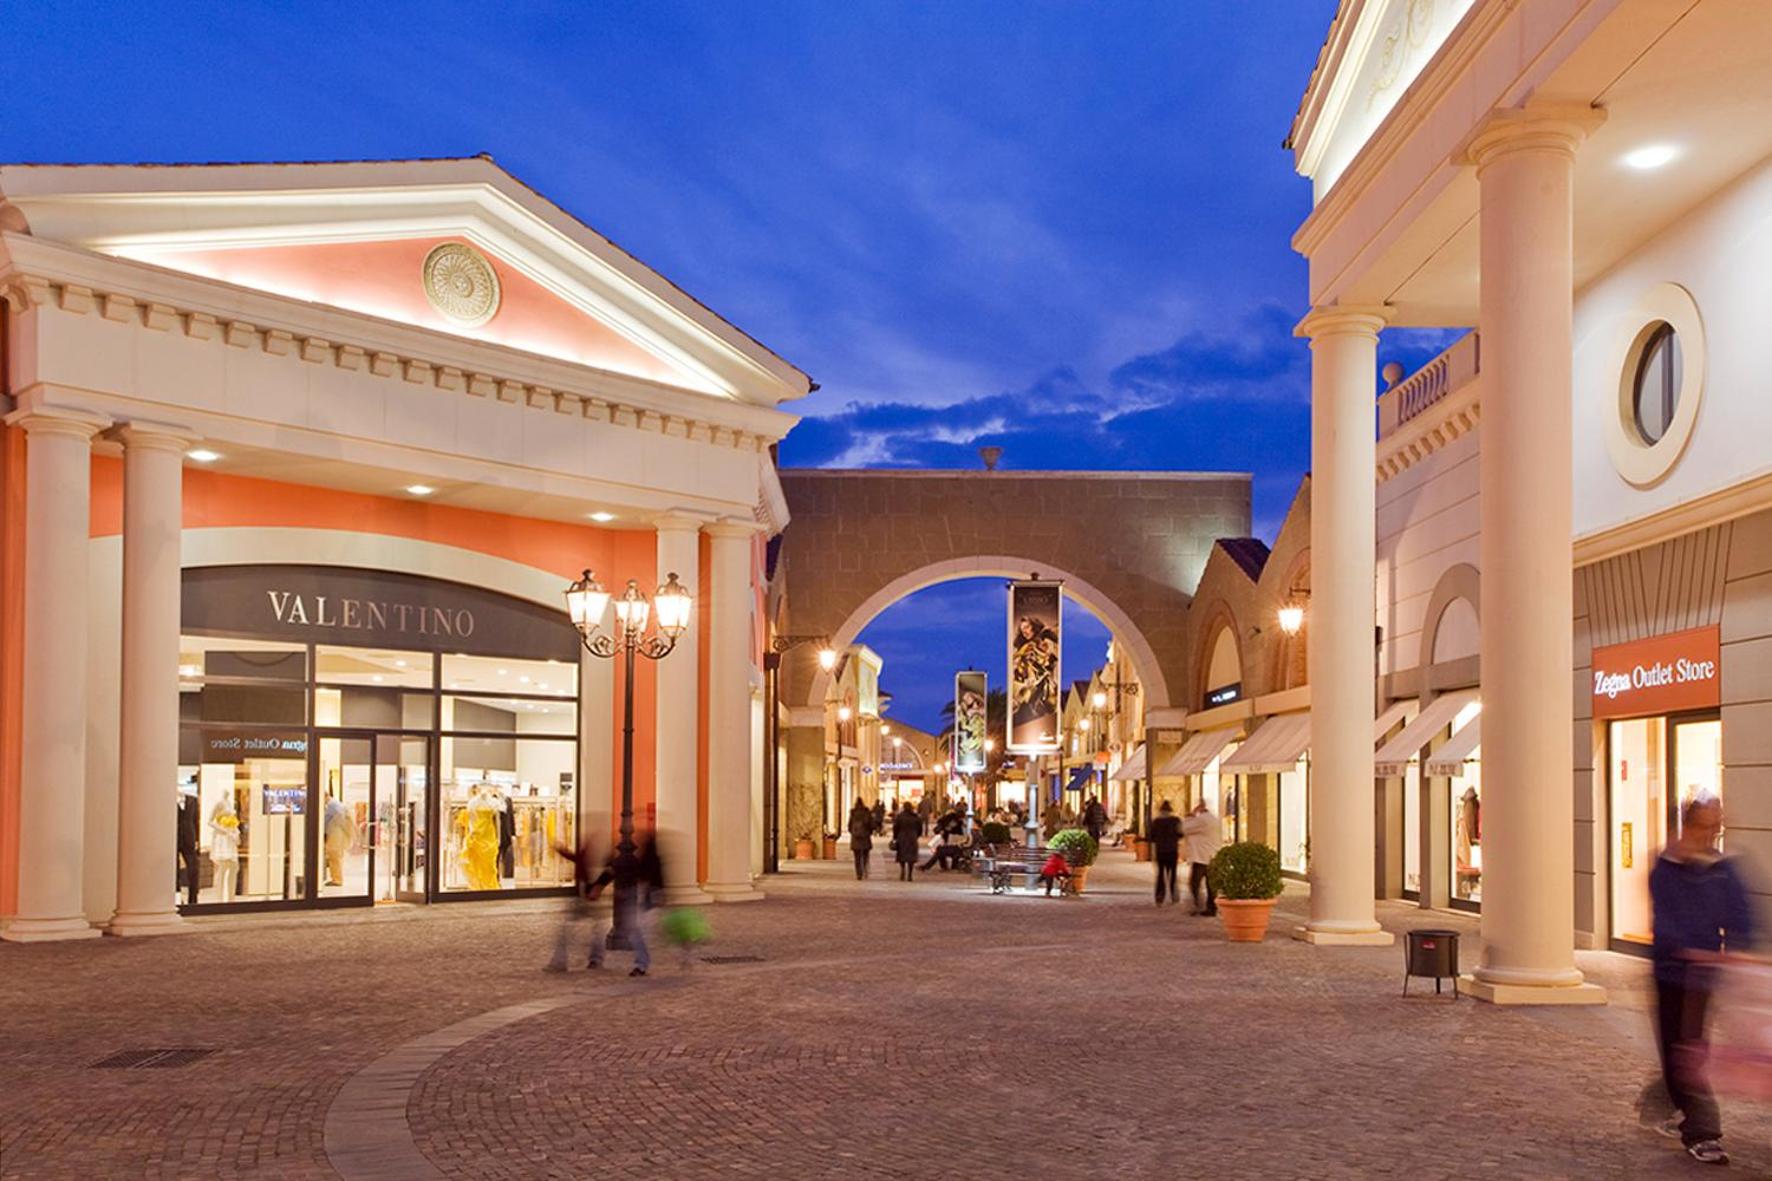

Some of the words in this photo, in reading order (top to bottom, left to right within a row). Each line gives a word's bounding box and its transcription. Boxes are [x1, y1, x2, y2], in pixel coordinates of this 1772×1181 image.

[267, 590, 475, 637] VALENTINO
[1594, 671, 1632, 698] Zegna
[1632, 662, 1674, 688] Outlet
[1676, 658, 1715, 682] Store
